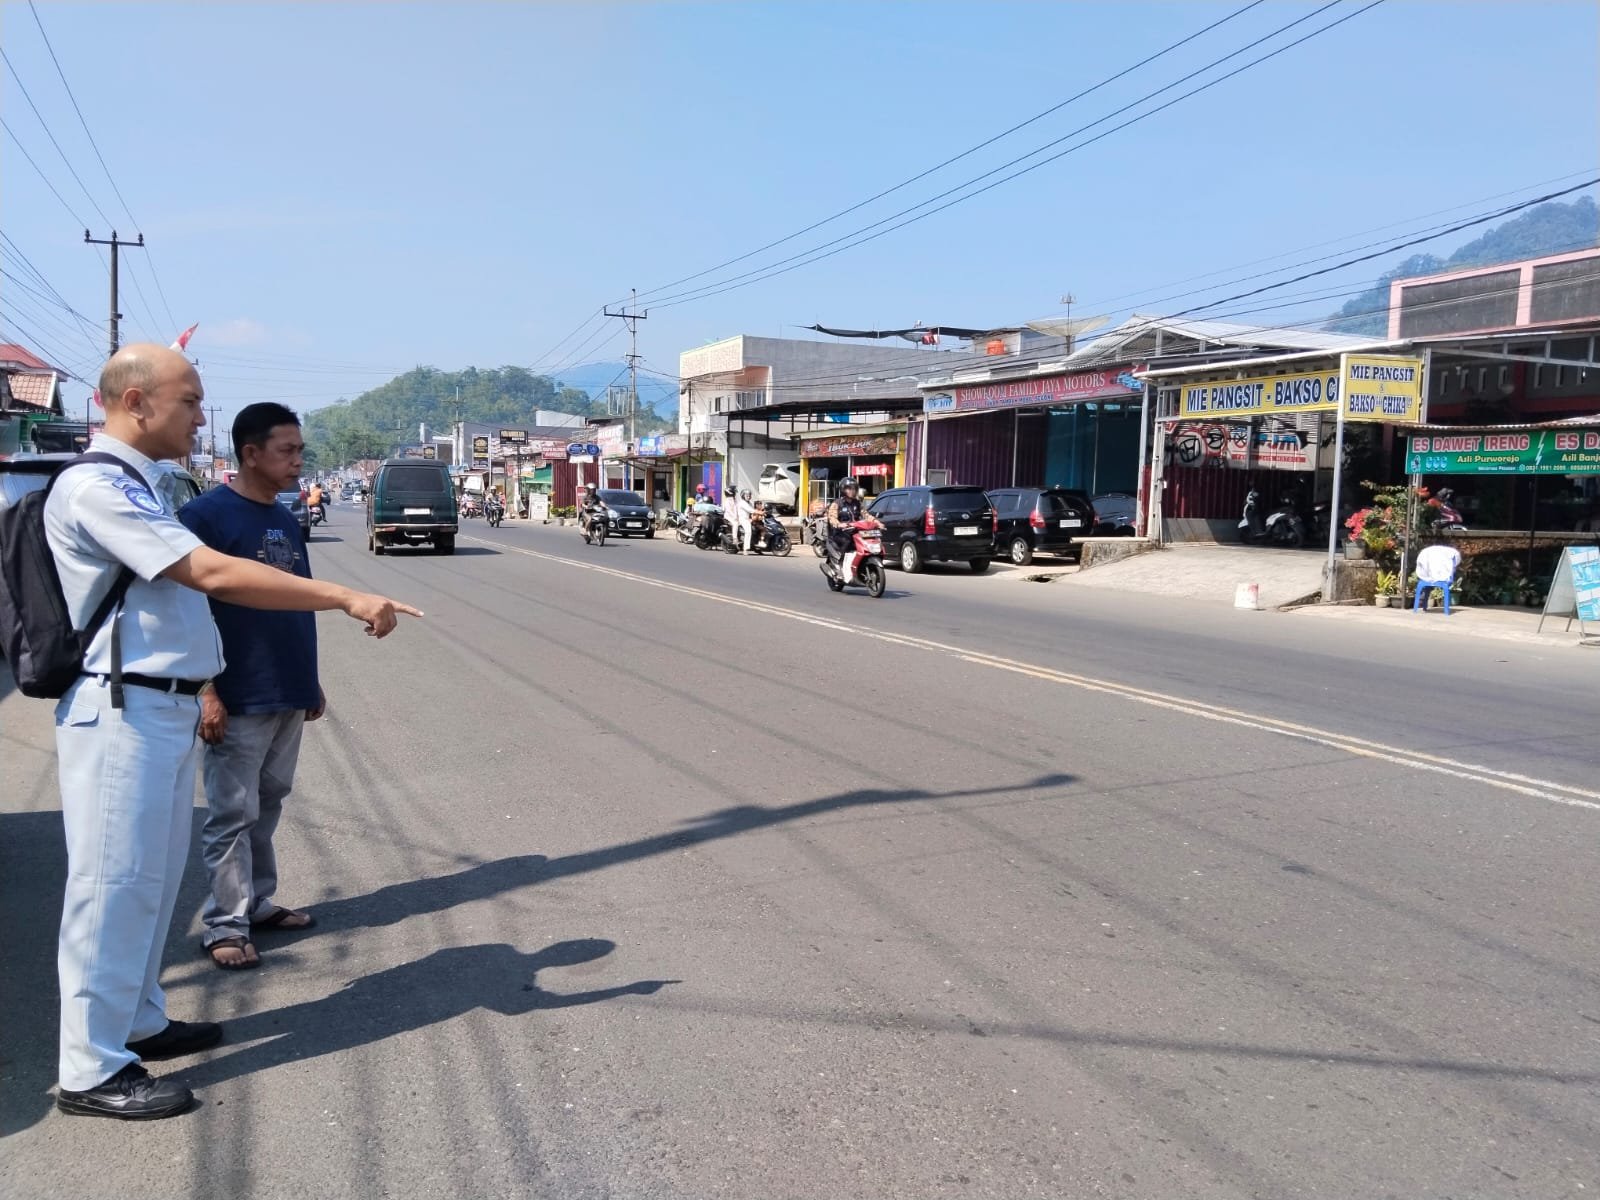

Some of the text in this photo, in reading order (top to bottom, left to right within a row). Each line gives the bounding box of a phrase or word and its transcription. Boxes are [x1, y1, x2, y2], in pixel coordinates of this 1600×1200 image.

[1351, 365, 1414, 381] MIE PANGSIT
[961, 384, 1007, 401] SHOWROOM
[1009, 380, 1039, 397] FAMILY
[1041, 377, 1060, 394] JAYA
[1064, 372, 1105, 391] MOTORS
[1187, 388, 1208, 411] MIE
[1211, 383, 1264, 410] PANGSIT
[1275, 378, 1322, 406] BAKSO
[1350, 394, 1375, 412] BAKSO
[1412, 434, 1530, 453] ES DAWET IRENG
[1555, 432, 1600, 450] ES D
[1457, 454, 1520, 464] Asli Purworejo
[1561, 453, 1600, 463] Asli Banj
